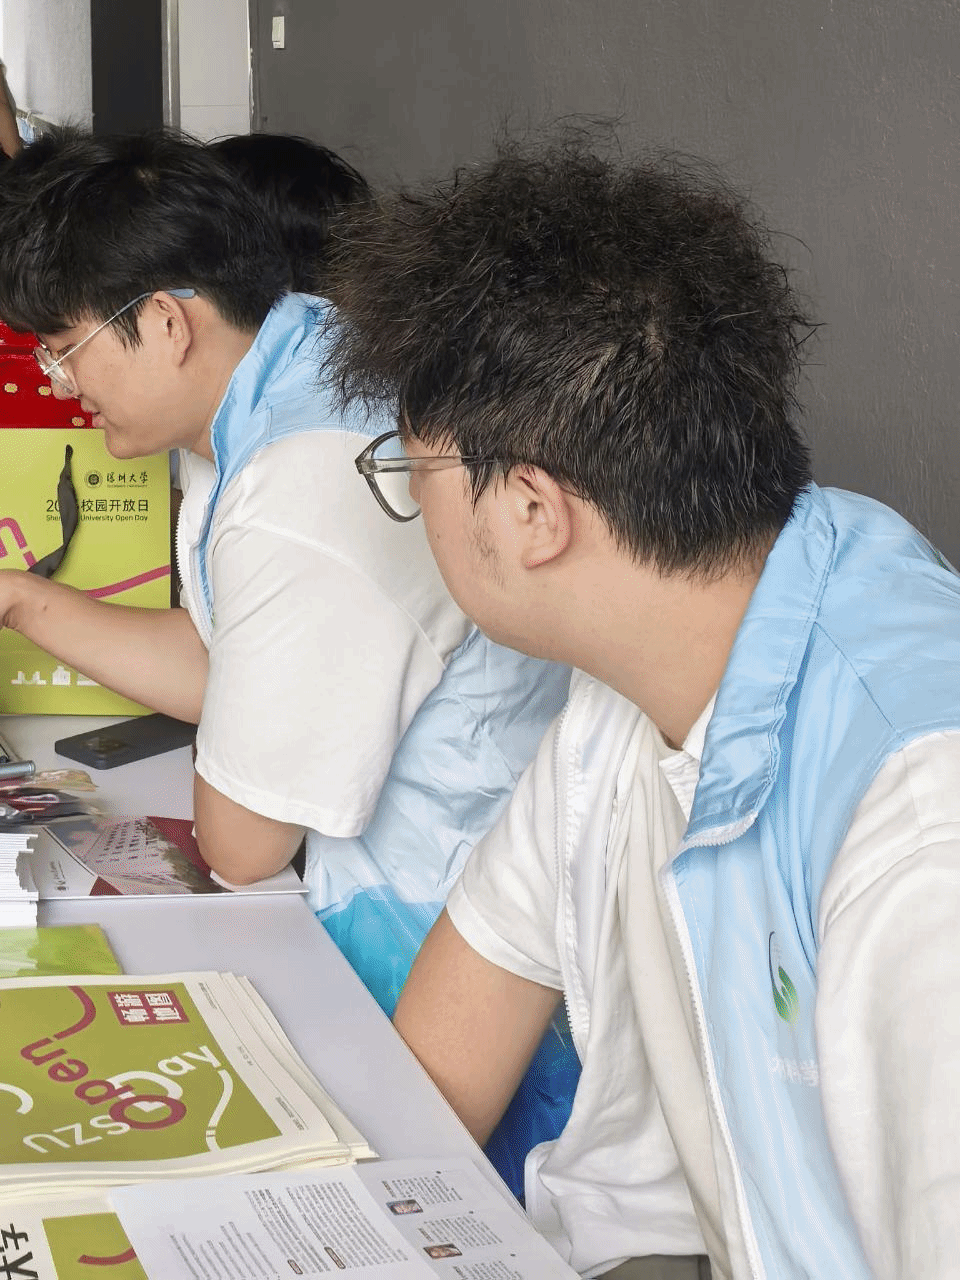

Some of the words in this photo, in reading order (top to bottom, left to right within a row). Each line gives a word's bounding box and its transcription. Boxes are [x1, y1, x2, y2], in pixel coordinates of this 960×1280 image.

[106, 471, 149, 484] 深圳大学
[46, 499, 149, 513] 20校园开放日
[80, 514, 113, 522] University
[115, 514, 132, 522] Open
[134, 514, 148, 522] Day
[20, 1037, 187, 1131] Open
[106, 1045, 222, 1112] Day
